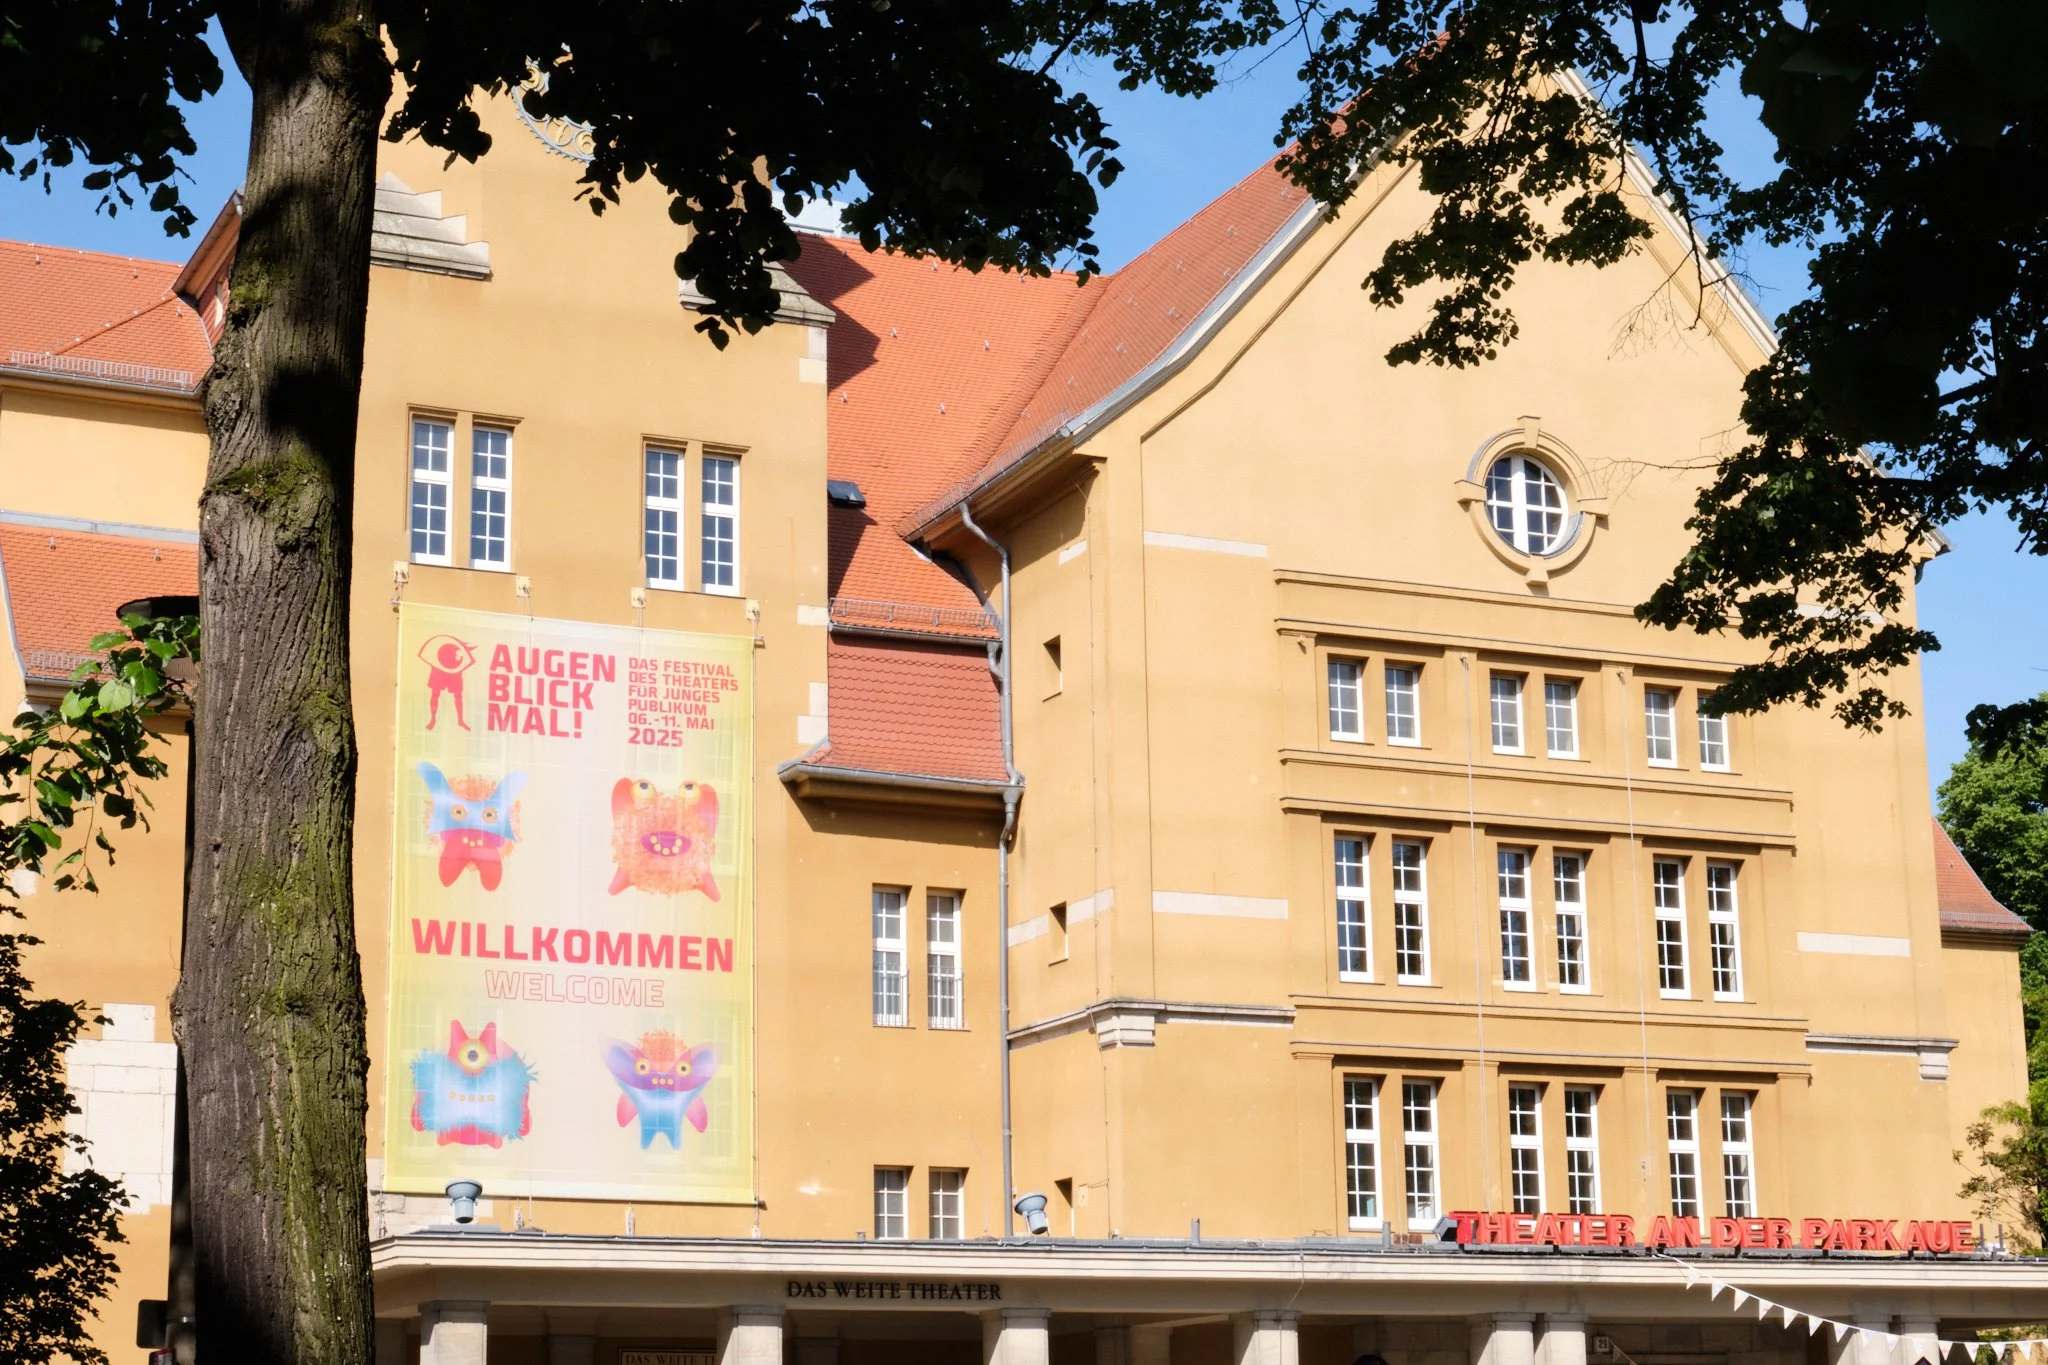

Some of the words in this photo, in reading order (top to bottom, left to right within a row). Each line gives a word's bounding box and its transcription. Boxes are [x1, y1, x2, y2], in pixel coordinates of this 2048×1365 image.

[489, 643, 616, 683] AUGEN
[628, 657, 658, 671] DAS
[663, 660, 735, 678] FESTIVAL
[488, 672, 594, 711] BLICK
[628, 671, 657, 685] DES
[662, 673, 739, 691] THEATERS
[628, 684, 658, 699] FÜR
[662, 687, 721, 704] JUNGES
[628, 698, 708, 717] PUBLIKUM
[487, 702, 582, 739] MAL!
[686, 716, 715, 731] MAI
[628, 726, 684, 748] 2025
[411, 918, 734, 973] WILLKOMMEN
[484, 969, 665, 1008] WELCOME
[1448, 1211, 1637, 1248] THEATER
[1643, 1215, 1701, 1248] AN
[1710, 1216, 1793, 1250] DER
[1800, 1217, 1977, 1252] PARKAUE
[787, 1280, 828, 1298] DAS
[833, 1281, 901, 1299] WEITE
[906, 1282, 1002, 1300] THEATER
[626, 1353, 651, 1365] DAS
